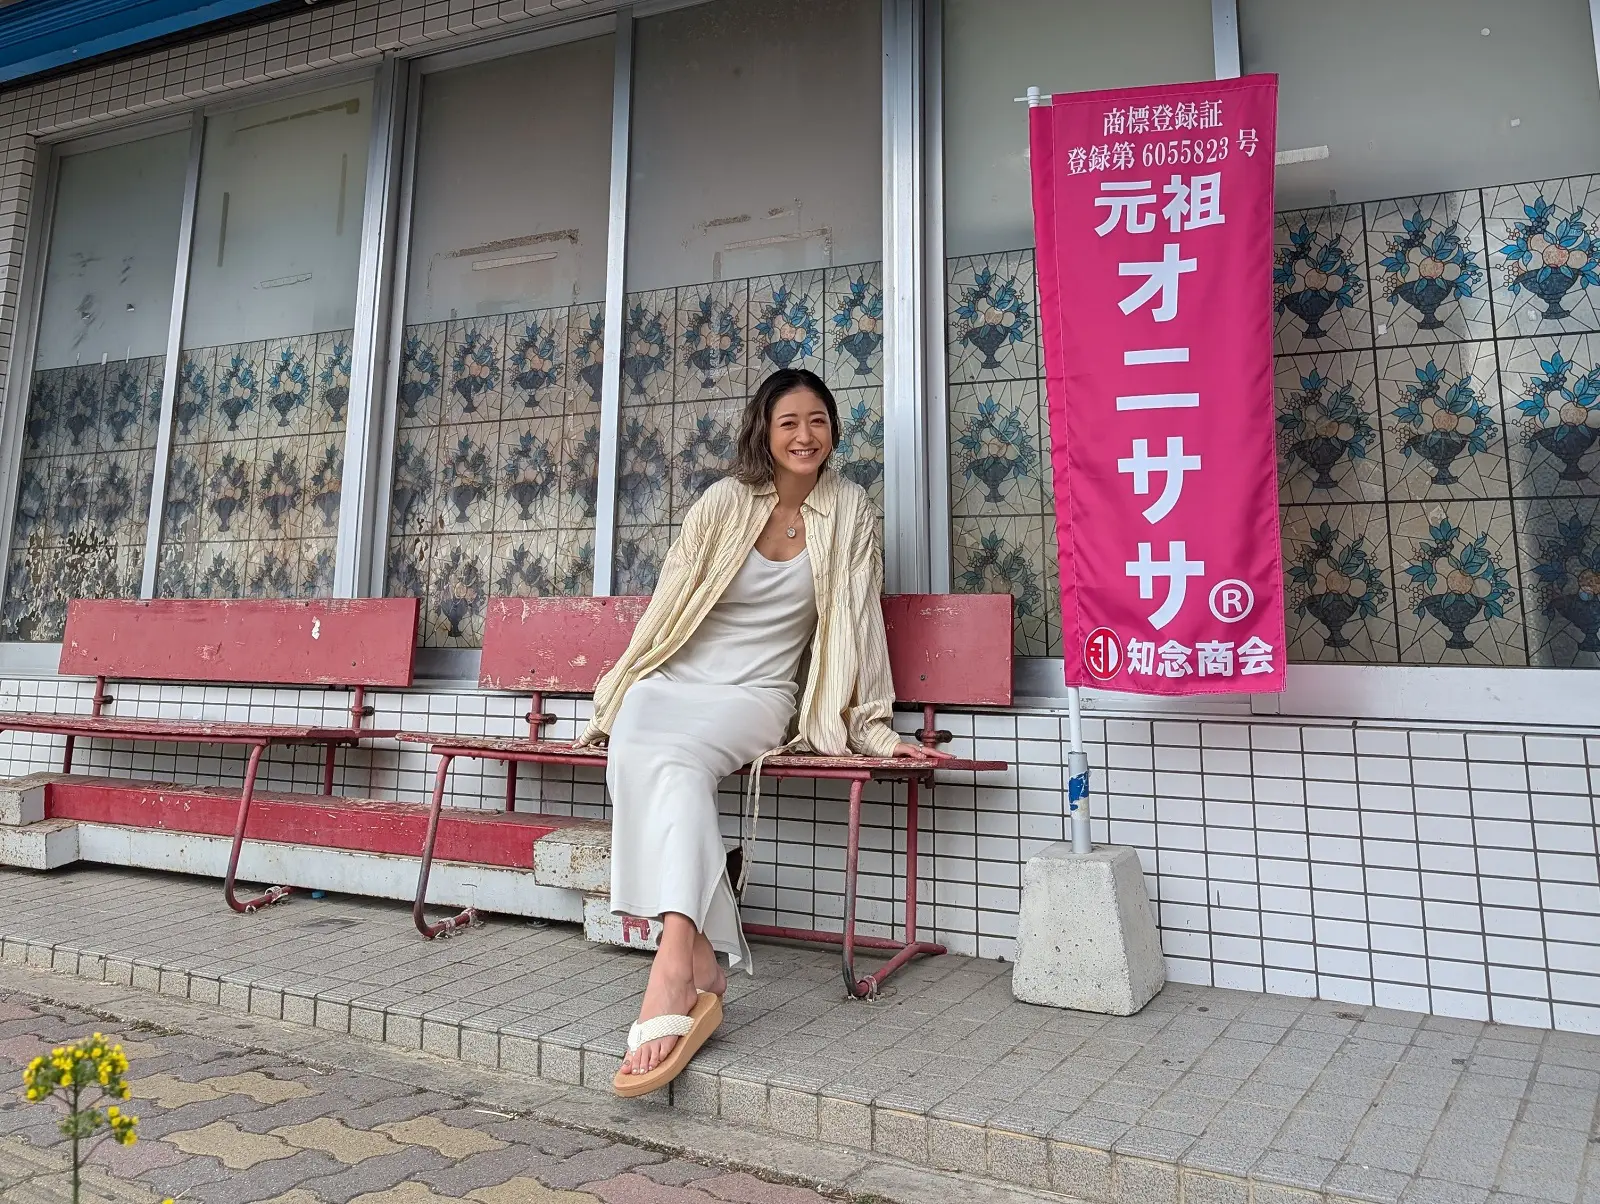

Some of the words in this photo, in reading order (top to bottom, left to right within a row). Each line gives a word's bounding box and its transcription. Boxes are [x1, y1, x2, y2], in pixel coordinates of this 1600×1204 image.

[1102, 99, 1224, 136] 商標登録証
[1094, 171, 1226, 238] 元祖
[1116, 243, 1205, 631] オニササ
[1126, 635, 1275, 678] 知念商会
